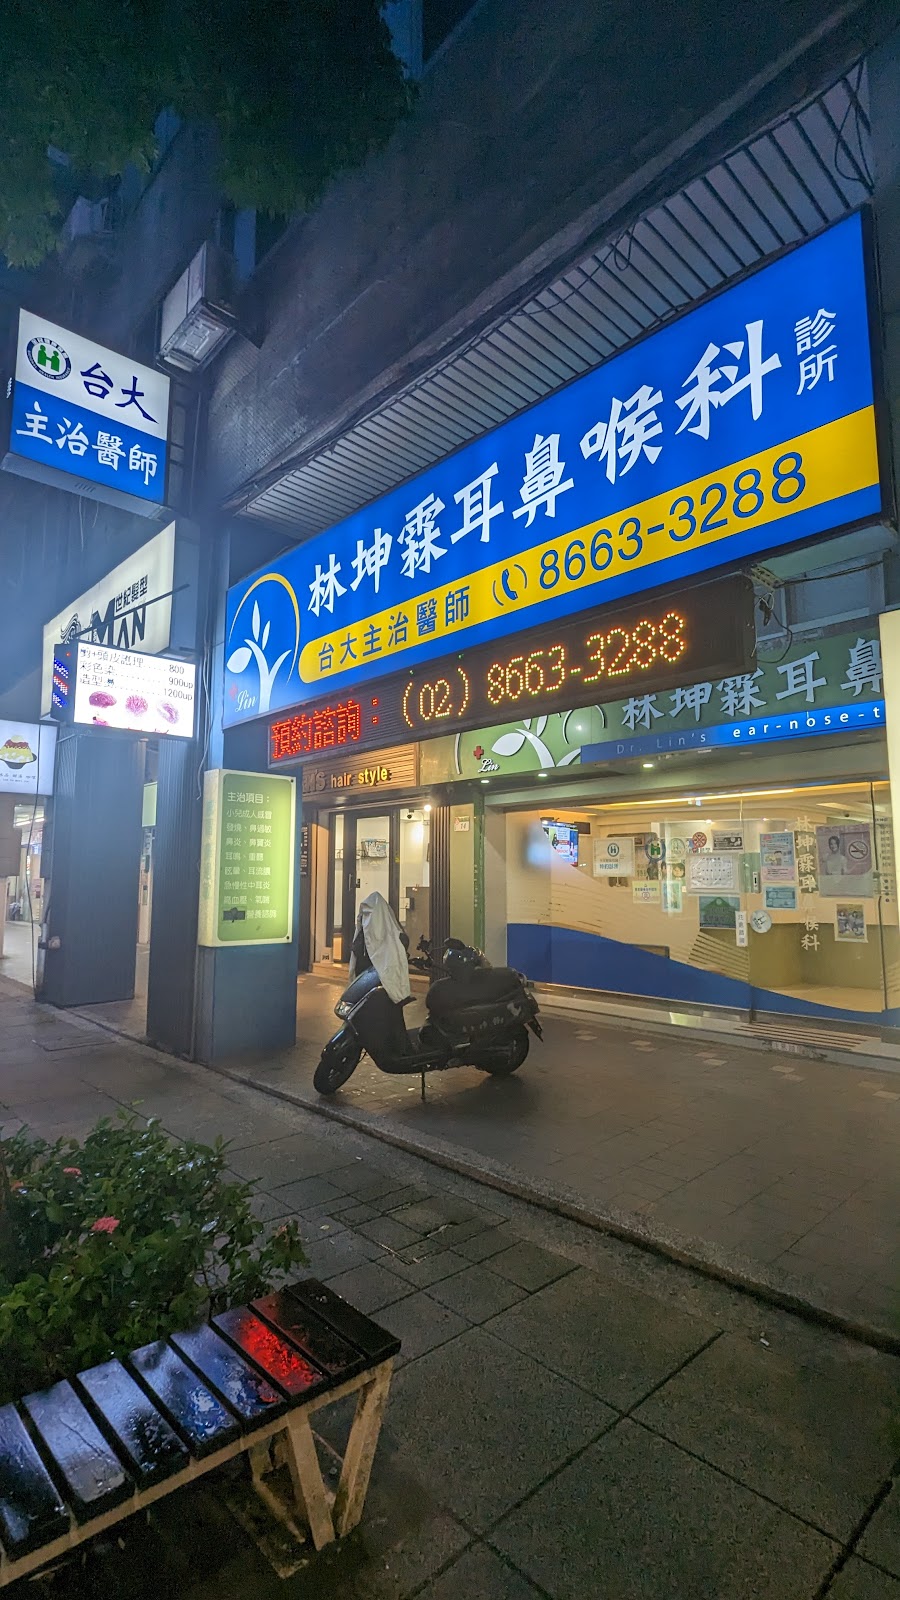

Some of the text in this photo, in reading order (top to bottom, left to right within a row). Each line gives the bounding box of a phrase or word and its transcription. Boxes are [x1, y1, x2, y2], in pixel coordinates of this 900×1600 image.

[794, 308, 838, 395] 診所
[80, 363, 159, 424] 台大
[16, 401, 157, 485] 主治醫師
[308, 319, 782, 617] 林坤霖耳鼻喉科
[318, 452, 806, 672] 台大主治醫師 8663-3288
[92, 597, 146, 650] MAN
[169, 664, 185, 675] 800
[403, 667, 469, 728] (02)
[487, 612, 685, 704] 8663-3288
[168, 677, 194, 689] 900up
[163, 688, 193, 702] 1200up
[235, 689, 256, 712] Lin
[617, 743, 643, 755] Dr.
[656, 732, 707, 749] Lin's
[478, 758, 499, 773] Lin
[330, 772, 352, 789] hair
[358, 766, 388, 787] style
[226, 808, 272, 820] 小兒成人感冒
